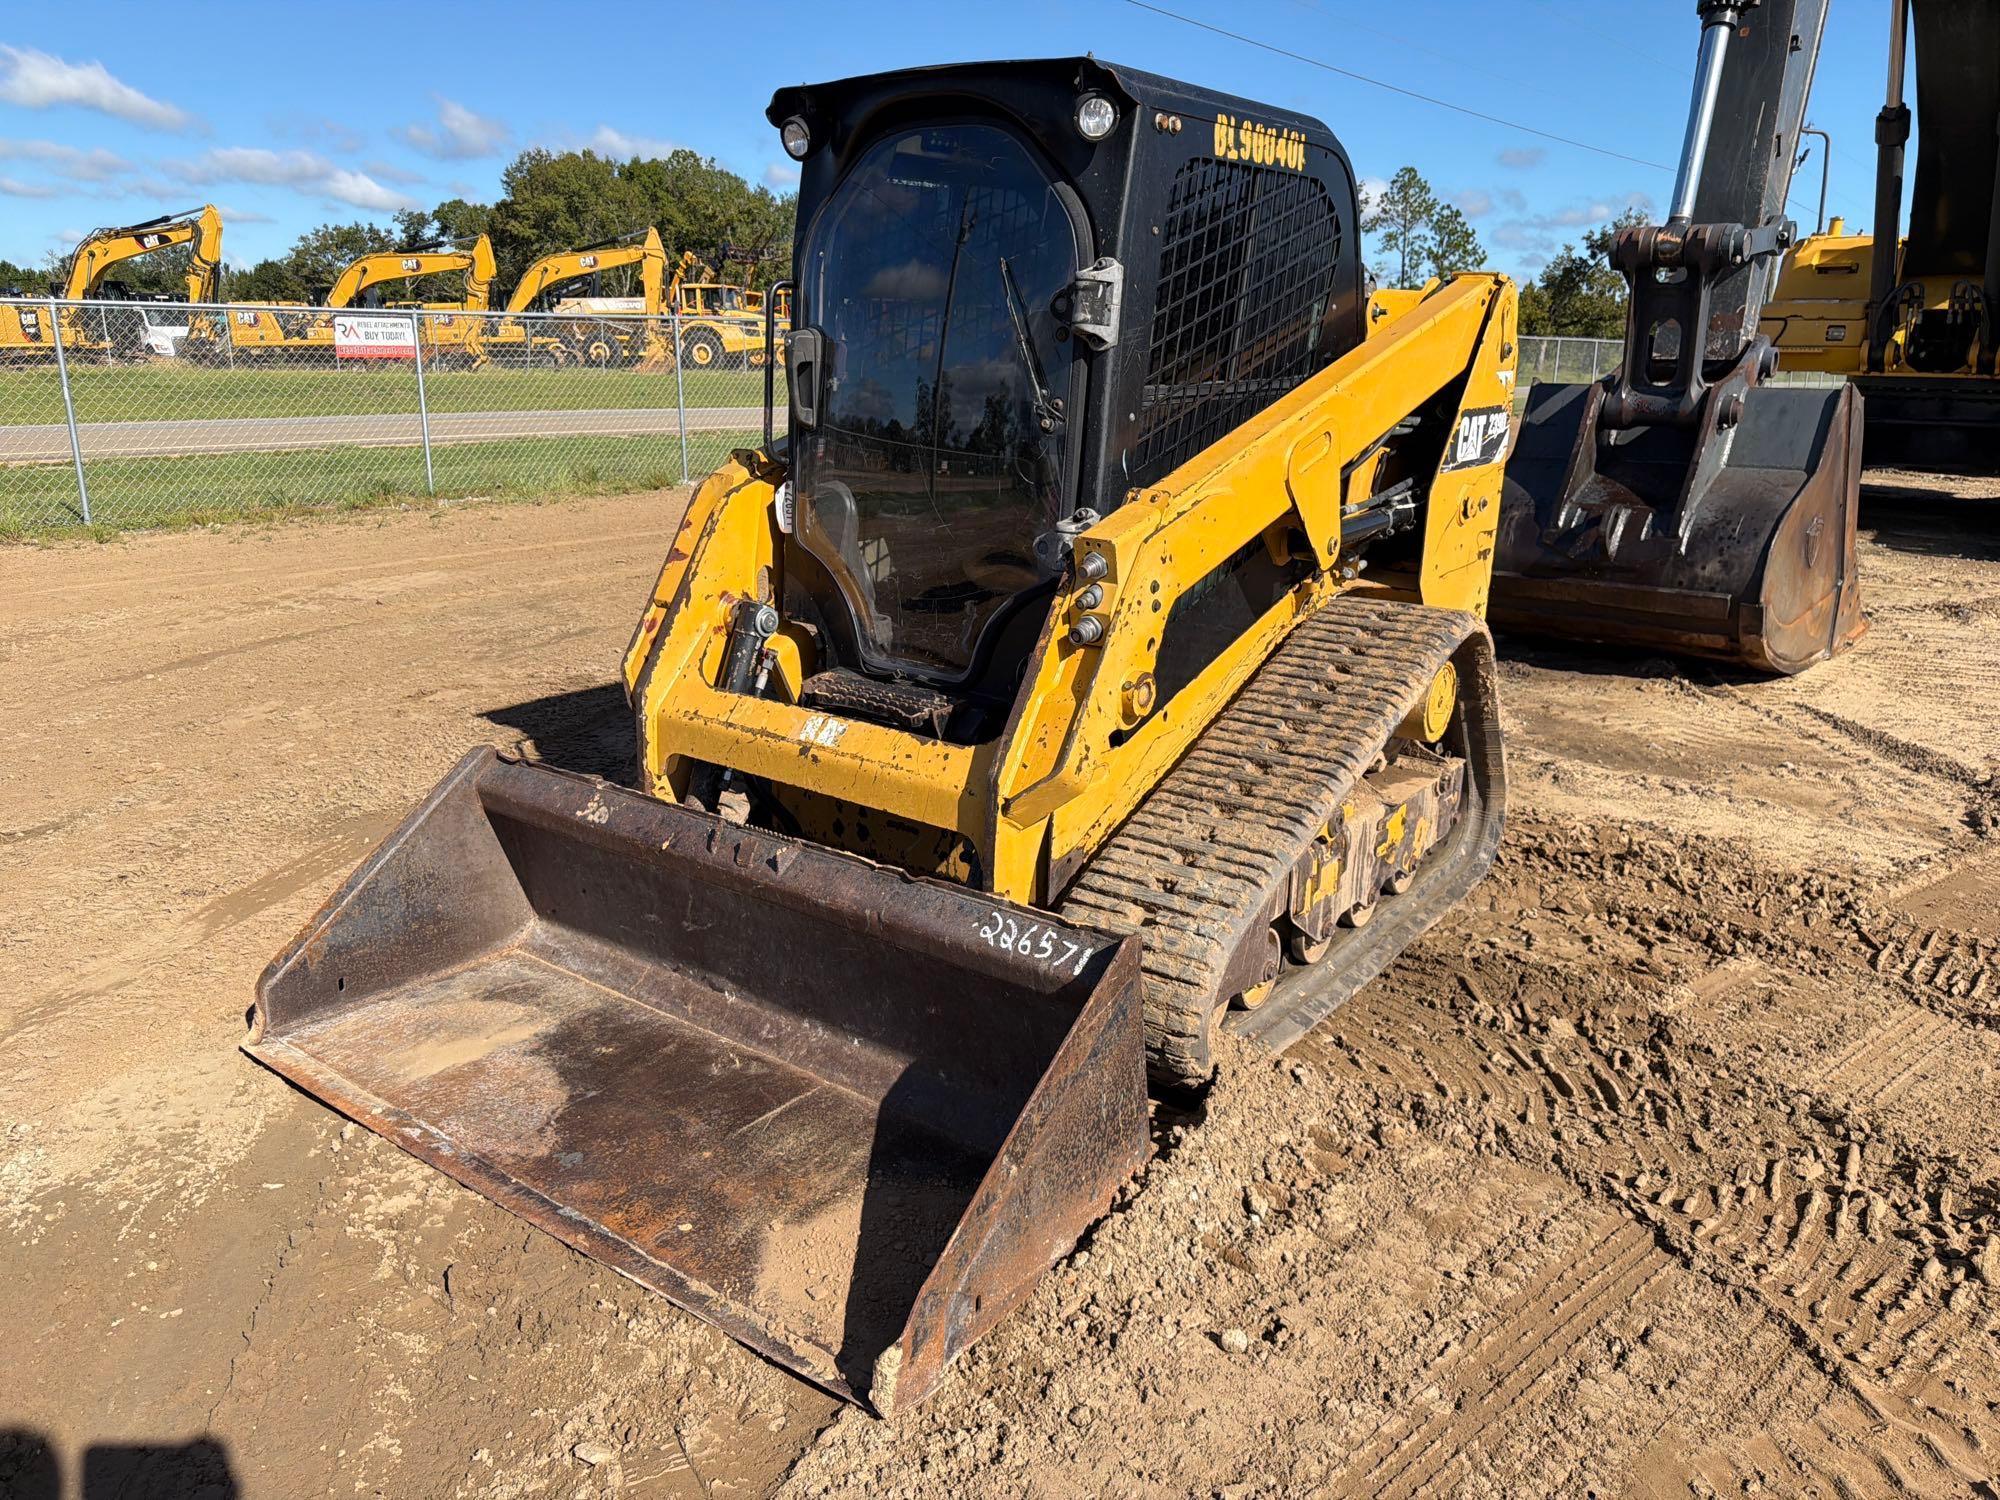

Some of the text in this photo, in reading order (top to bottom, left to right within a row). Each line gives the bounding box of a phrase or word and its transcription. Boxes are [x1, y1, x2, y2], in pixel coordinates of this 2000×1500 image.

[143, 234, 160, 249] CAT
[402, 258, 417, 270] CAT
[580, 256, 595, 267] CAT
[21, 313, 37, 325] CAT
[237, 312, 255, 325] CAT
[364, 331, 406, 341] BUY TODAY!
[1457, 414, 1487, 462] CAT
